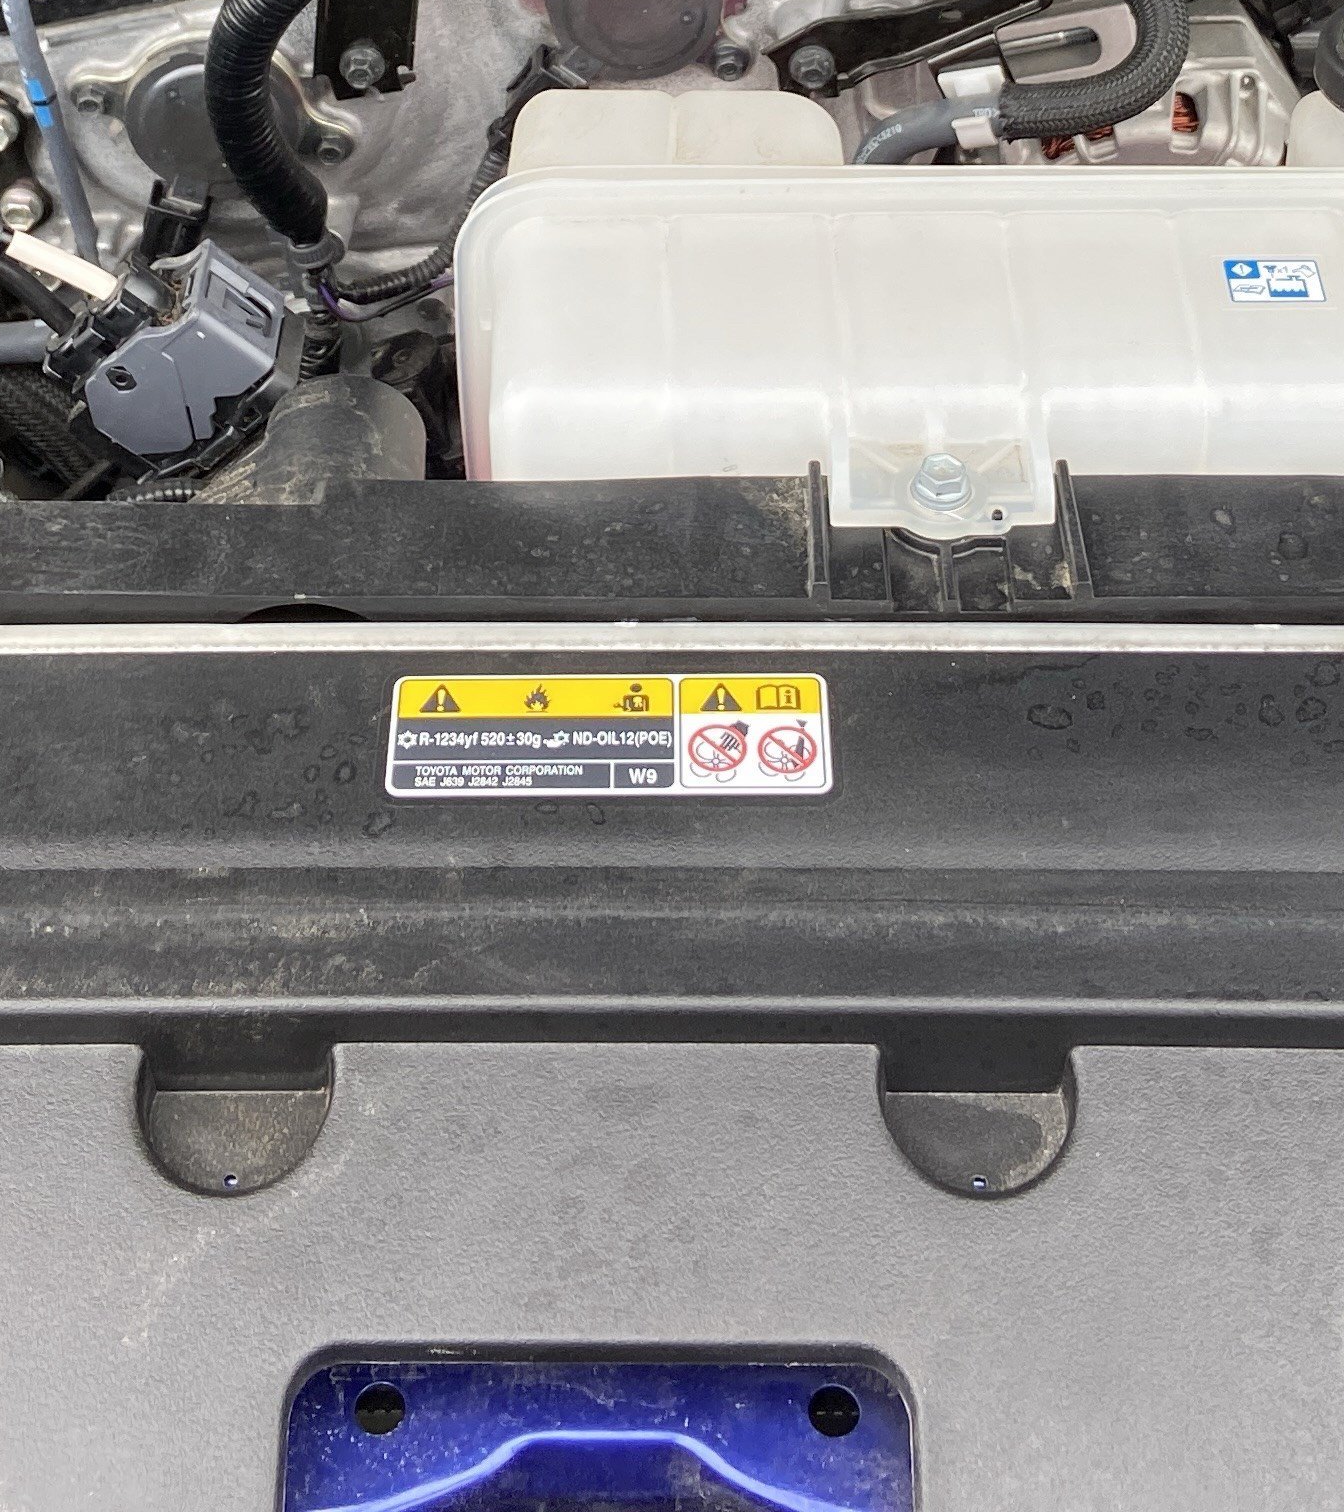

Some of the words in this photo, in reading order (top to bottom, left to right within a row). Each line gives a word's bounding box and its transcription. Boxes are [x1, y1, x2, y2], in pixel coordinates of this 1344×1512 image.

[419, 731, 479, 749] R-1234yf
[480, 731, 542, 749] 520±30g
[572, 730, 673, 748] ND-OIL12(POE)
[415, 765, 458, 776] TOYOTA
[461, 765, 502, 776] MOTOR
[505, 764, 584, 776] CORPORATION
[628, 767, 658, 785] W9
[414, 776, 437, 787] SAE
[439, 776, 465, 787] J639
[467, 776, 499, 787] J2842
[501, 776, 533, 787] J2845
